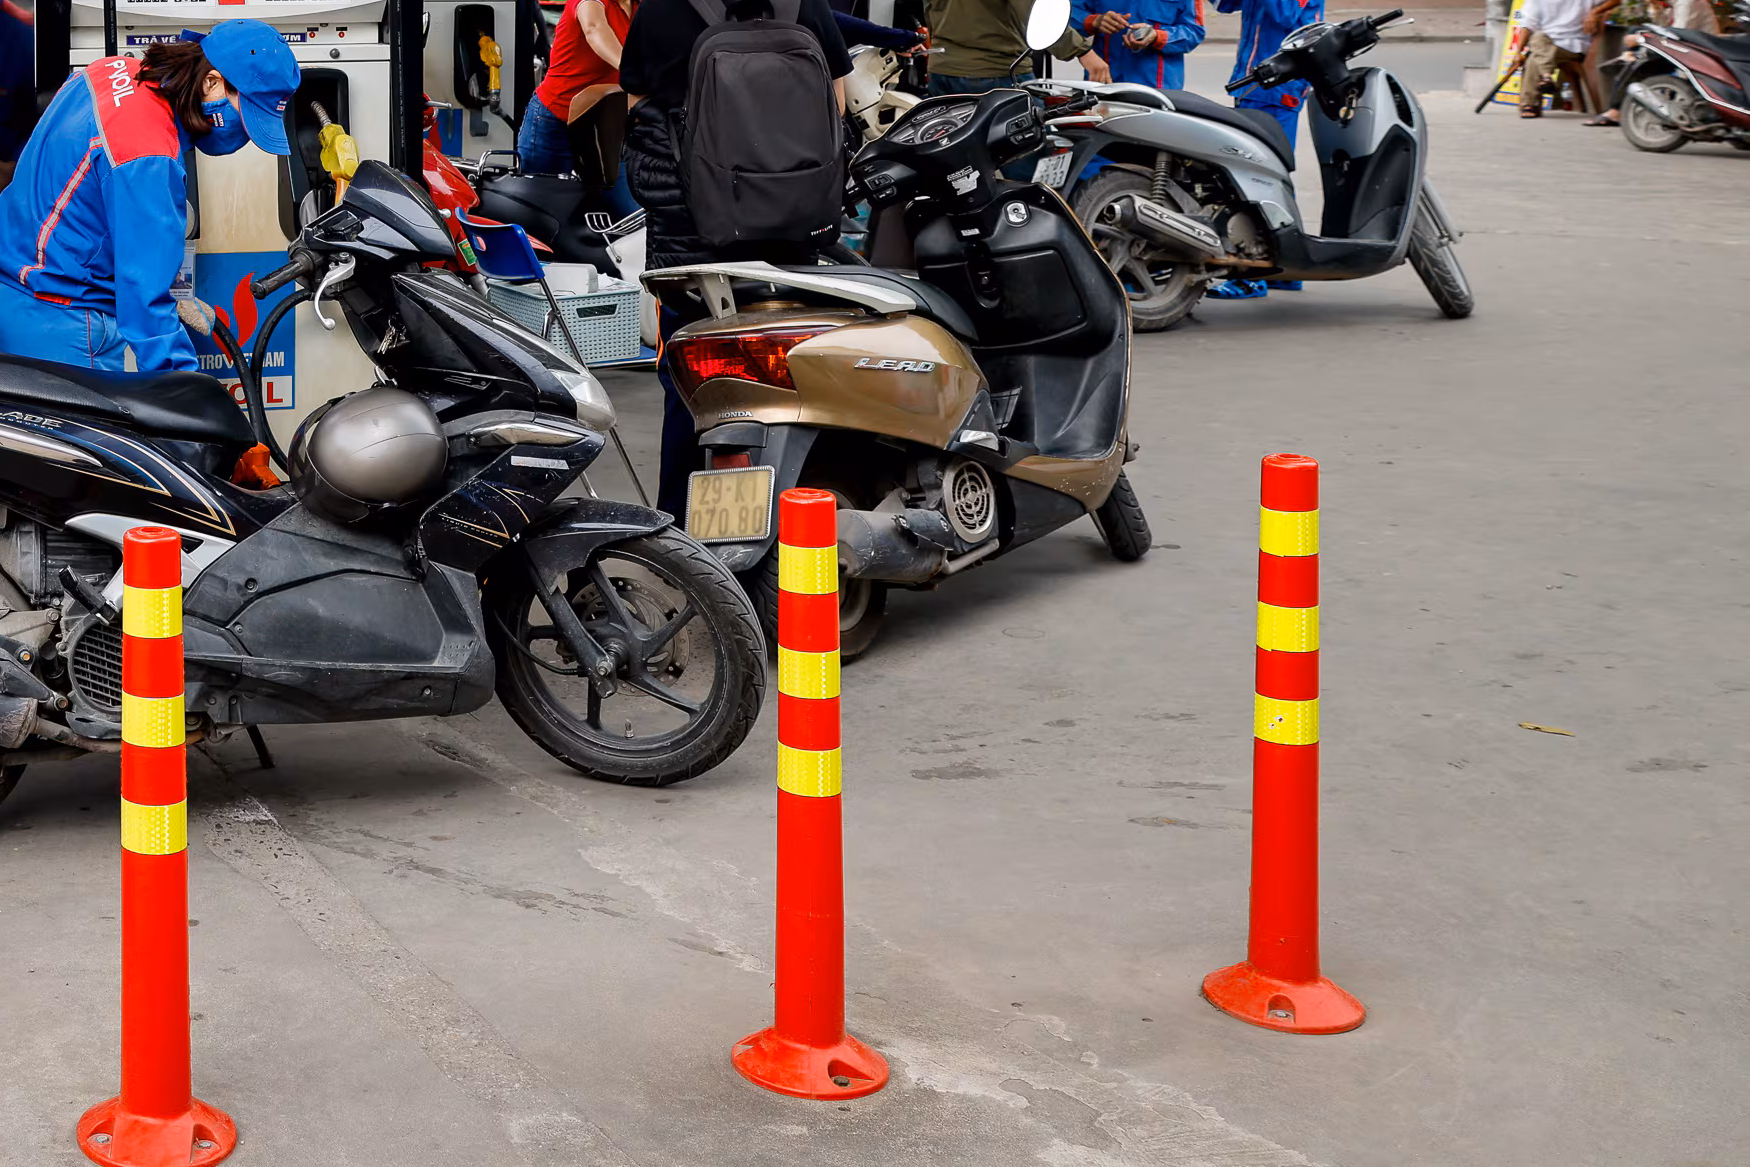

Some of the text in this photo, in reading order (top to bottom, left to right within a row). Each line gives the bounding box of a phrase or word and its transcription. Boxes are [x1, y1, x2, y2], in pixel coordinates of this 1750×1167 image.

[105, 59, 134, 107] PVOIL
[854, 357, 936, 373] LEAD
[718, 411, 754, 420] HONDA
